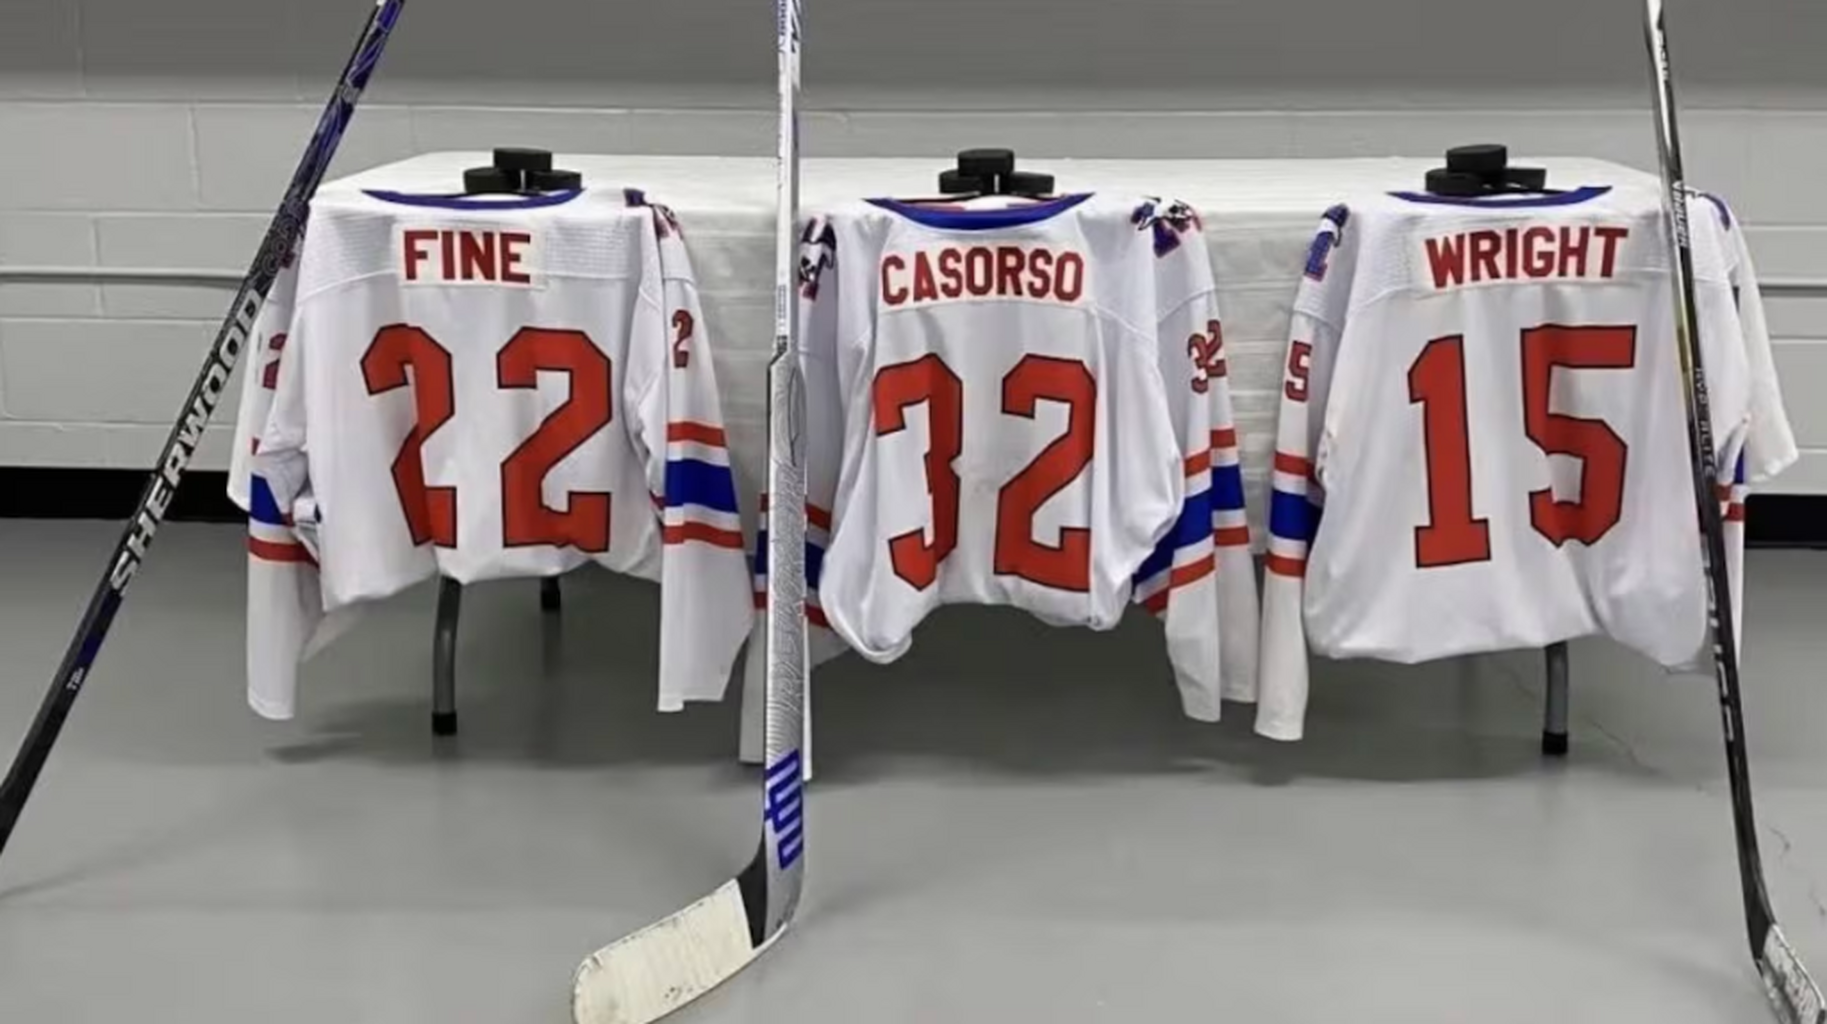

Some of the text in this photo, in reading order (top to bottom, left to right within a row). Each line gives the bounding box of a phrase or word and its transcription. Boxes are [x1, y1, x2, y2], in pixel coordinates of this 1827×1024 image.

[403, 230, 531, 283] FINE
[881, 247, 1084, 305] CASORSO
[1425, 226, 1628, 289] WRIGHT
[672, 309, 694, 369] 2
[1187, 319, 1227, 394] 32
[1284, 340, 1313, 403] 5
[109, 288, 266, 597] SHERWOOD
[360, 323, 612, 554] 22
[873, 353, 1097, 593] 32
[1407, 322, 1638, 569] 15
